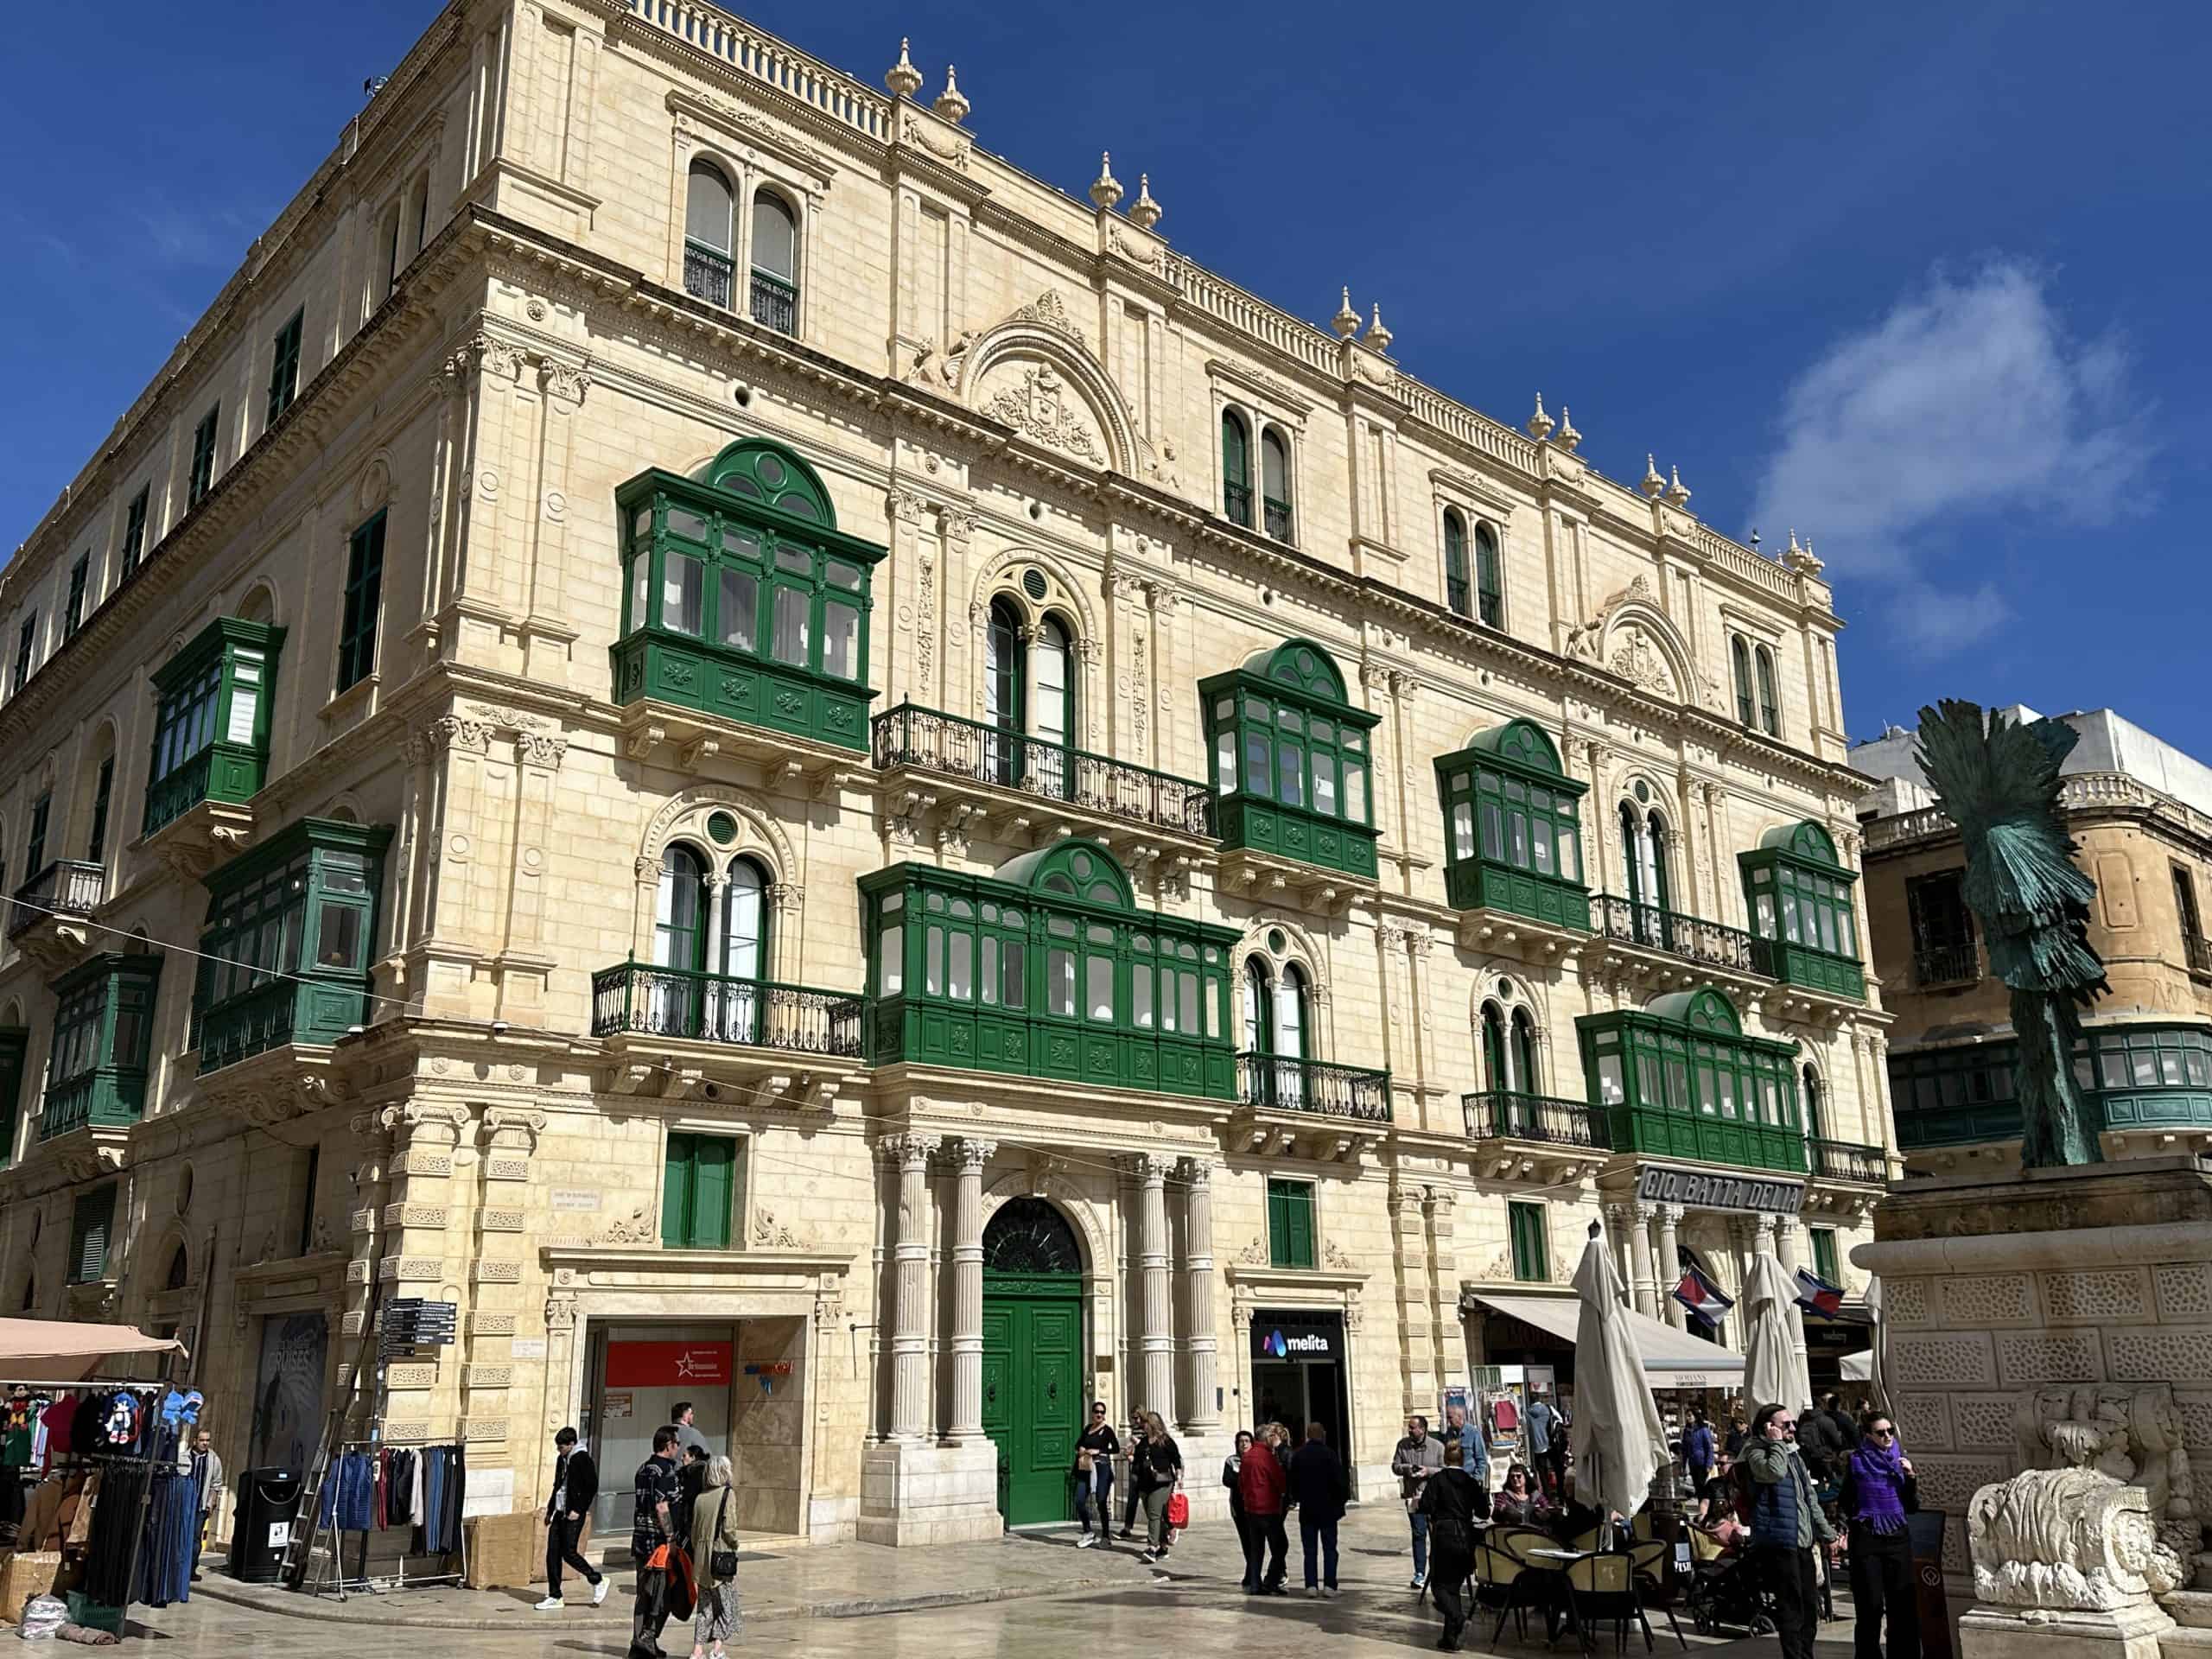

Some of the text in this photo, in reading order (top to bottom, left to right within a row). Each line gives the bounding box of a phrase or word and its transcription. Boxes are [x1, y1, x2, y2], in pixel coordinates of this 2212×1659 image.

[1644, 1170, 1799, 1213] GIO. BATTA DELIA
[1287, 1333, 1329, 1351] melita
[269, 1348, 311, 1372] CRUISES
